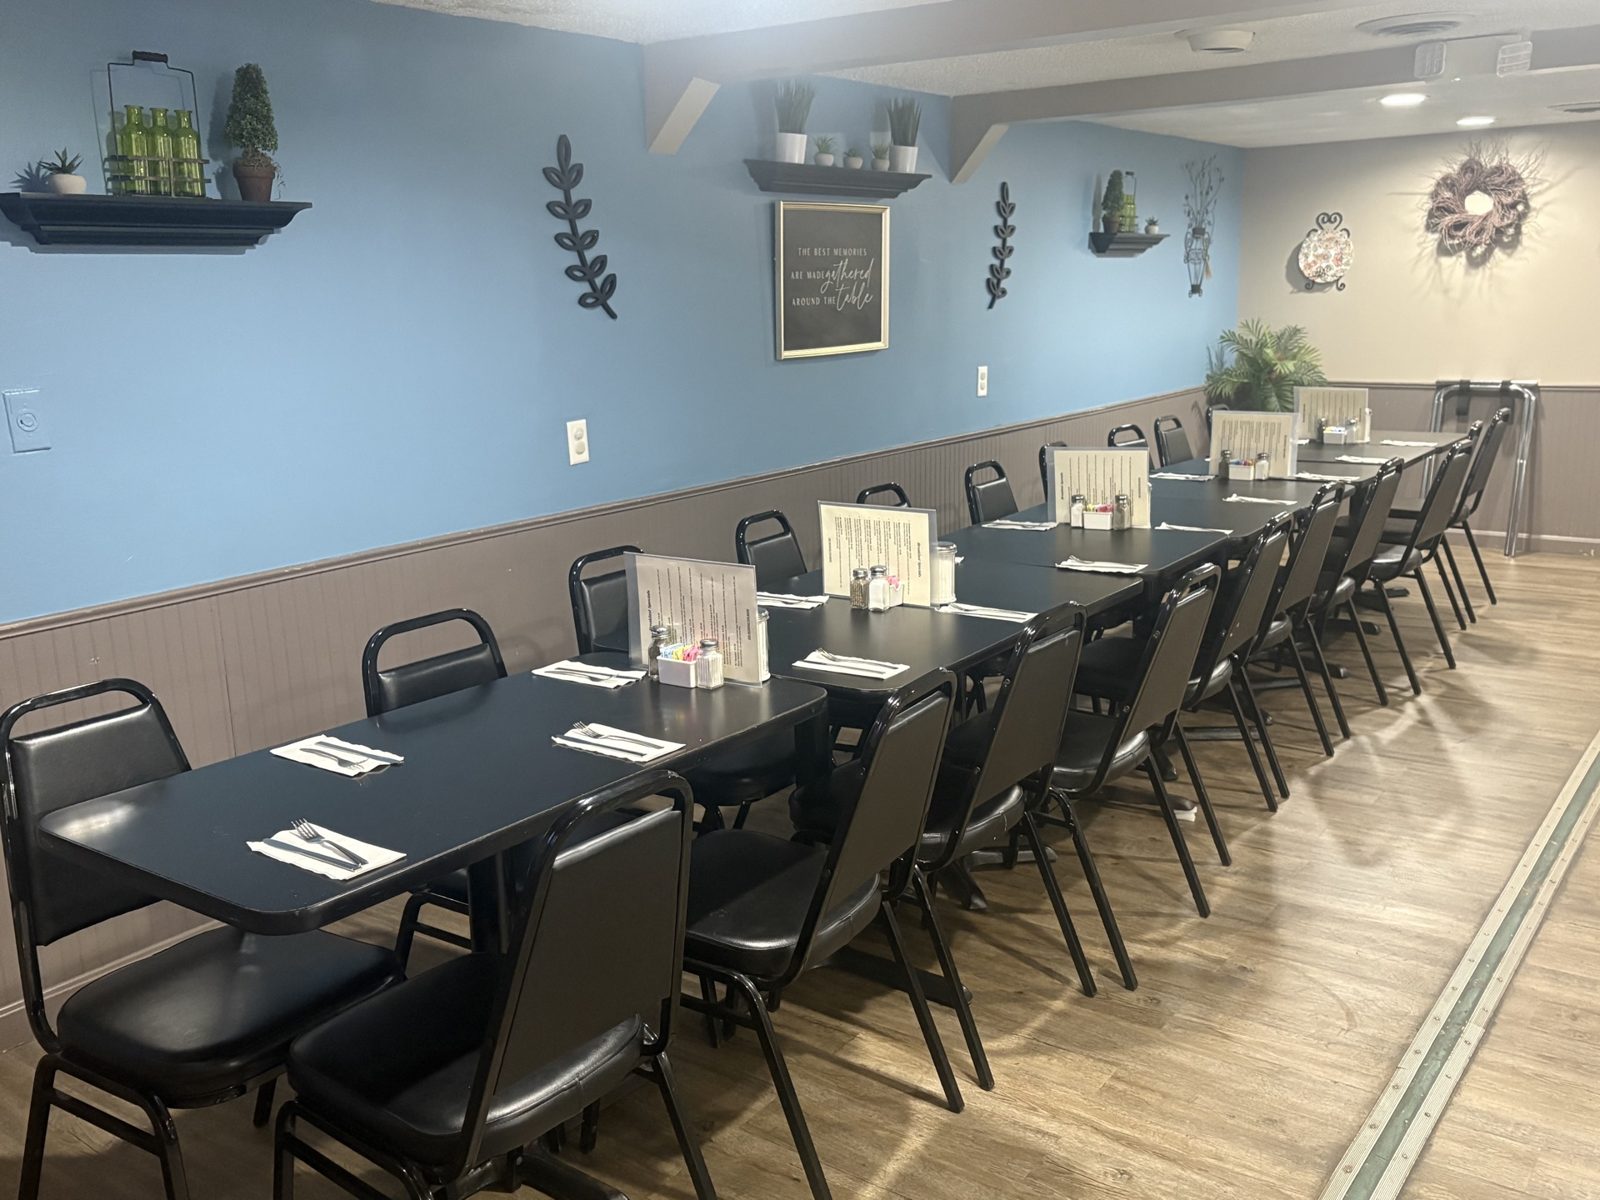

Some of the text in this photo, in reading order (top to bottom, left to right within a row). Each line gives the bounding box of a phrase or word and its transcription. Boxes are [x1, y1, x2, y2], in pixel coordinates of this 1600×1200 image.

[798, 247, 867, 257] THE BEST MEMORIES
[791, 257, 875, 295] ARE MADE gathered
[792, 281, 874, 312] AROUND THE table
